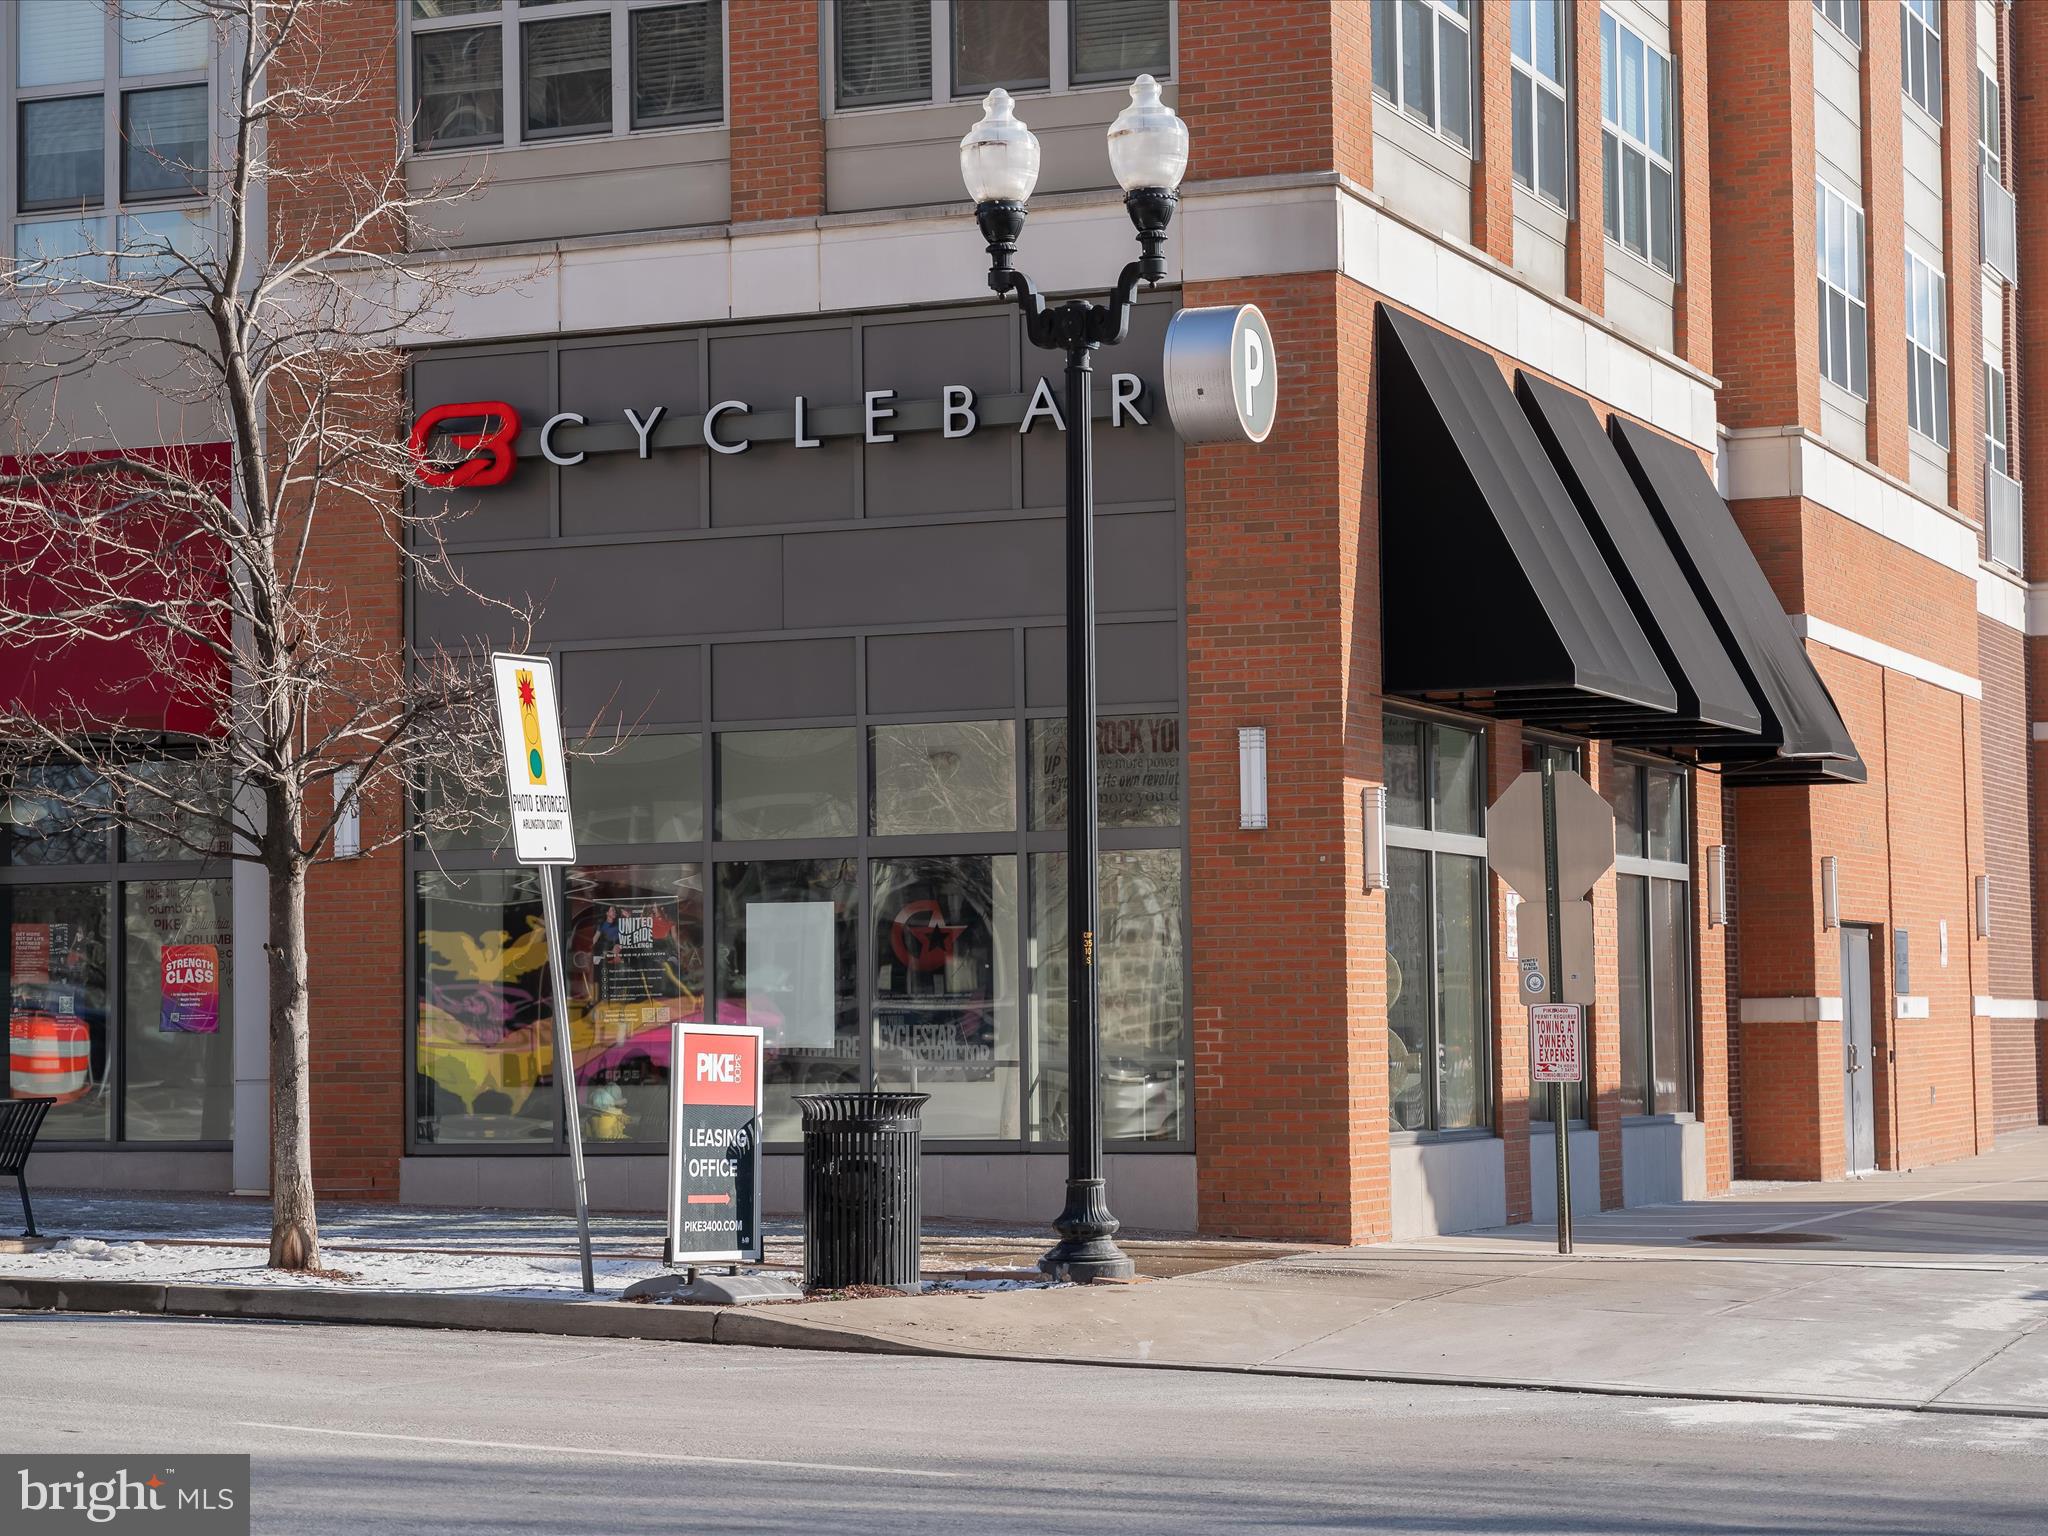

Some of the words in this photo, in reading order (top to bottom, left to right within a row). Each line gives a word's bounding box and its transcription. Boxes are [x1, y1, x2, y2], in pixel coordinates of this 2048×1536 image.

[1244, 326, 1265, 417] P
[540, 373, 1149, 465] CYCLEBAR
[512, 793, 534, 812] PHOTO
[535, 794, 568, 813] ENFORCED
[522, 818, 545, 830] ARLINGTON
[546, 818, 563, 831] COUNTY
[618, 917, 653, 934] UNITED
[618, 933, 632, 946] WE
[633, 927, 654, 944] RIDE
[166, 957, 214, 971] STRENGTH
[166, 968, 214, 984] CLASS
[1536, 1020, 1565, 1034] TOWING
[1567, 1020, 1576, 1034] AT
[878, 1023, 957, 1052] CYCLESTAR
[1538, 1034, 1574, 1048] OWNER'S
[1539, 1048, 1575, 1062] EXPENSE
[696, 1052, 735, 1083] PIKE
[734, 1054, 742, 1084] 3400
[689, 1128, 747, 1148] LEASING
[688, 1158, 738, 1178] OFFICE
[684, 1219, 743, 1233] PIKE3400.COM
